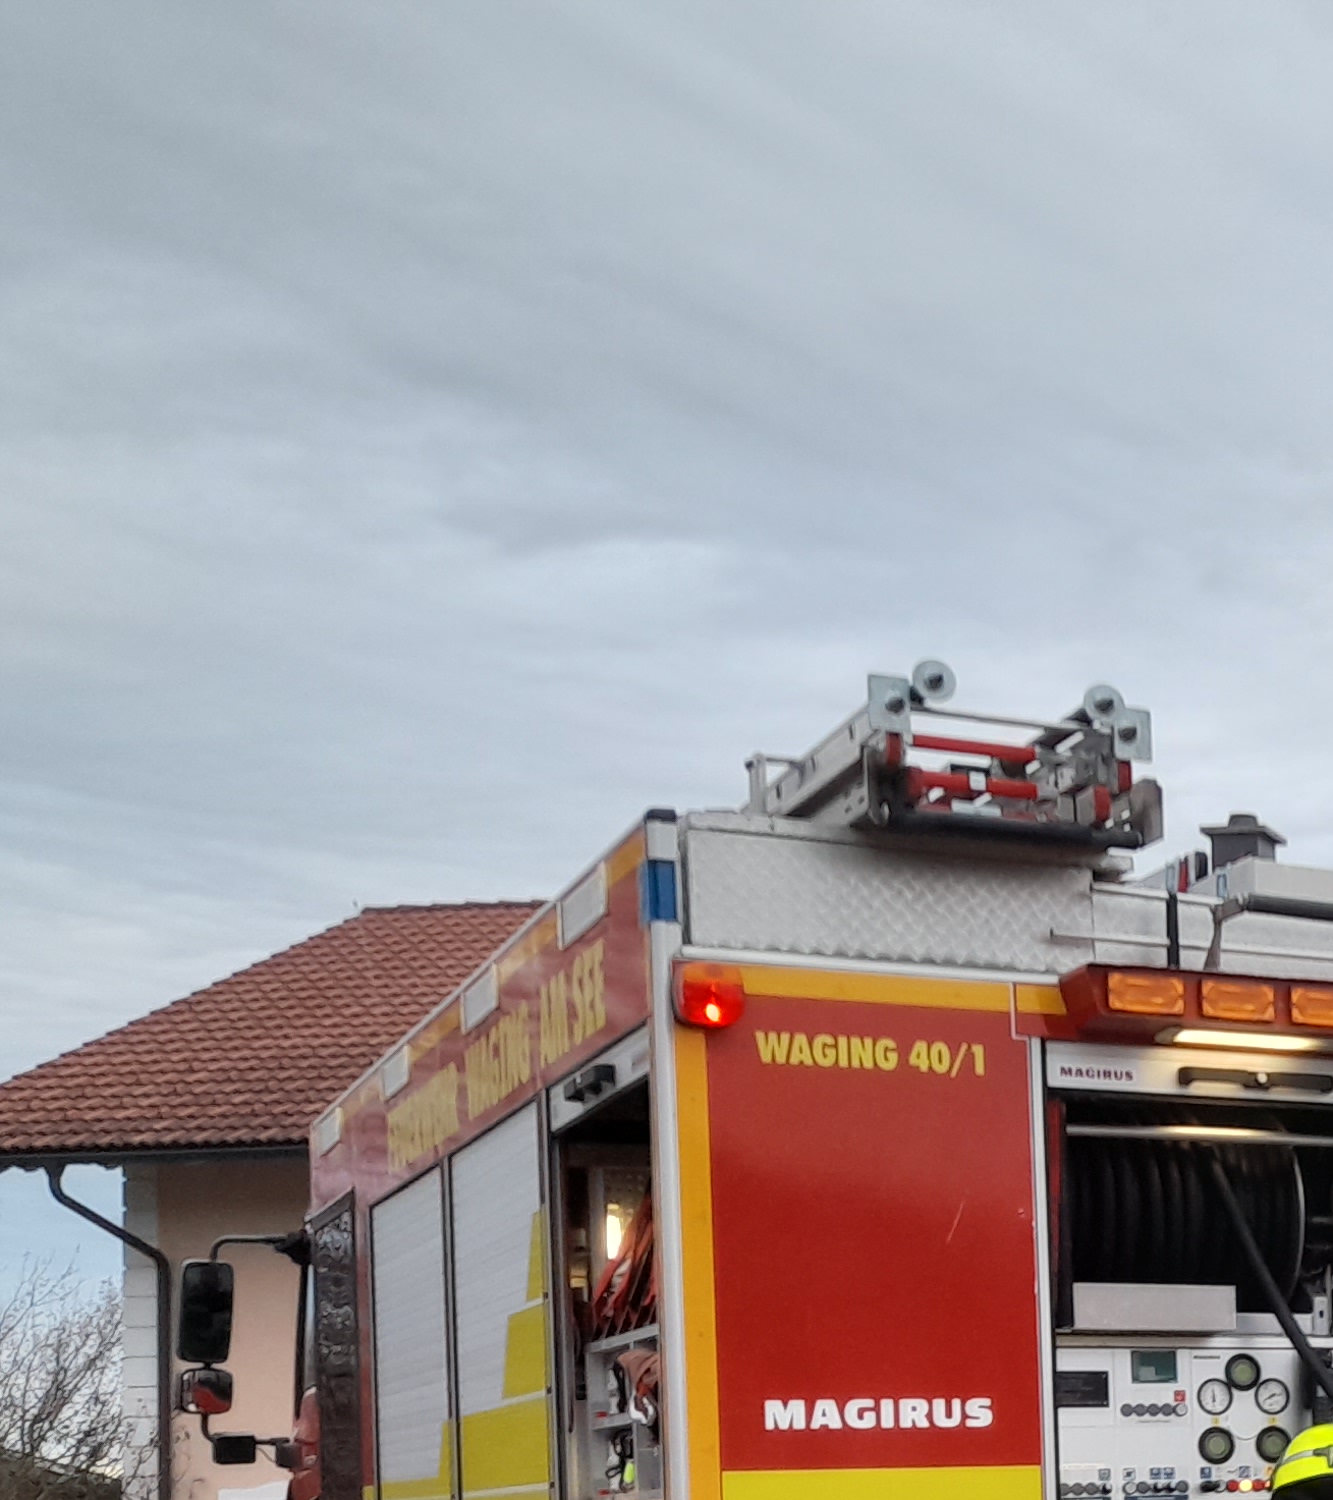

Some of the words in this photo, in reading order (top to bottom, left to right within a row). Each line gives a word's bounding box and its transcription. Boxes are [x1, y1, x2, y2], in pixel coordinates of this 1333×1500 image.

[573, 938, 607, 1046] SEE
[755, 1030, 899, 1072] WAGING
[908, 1040, 986, 1078] 40/1
[1059, 1066, 1134, 1081] MAGIRUS
[764, 1398, 994, 1431] MAGIRUS
